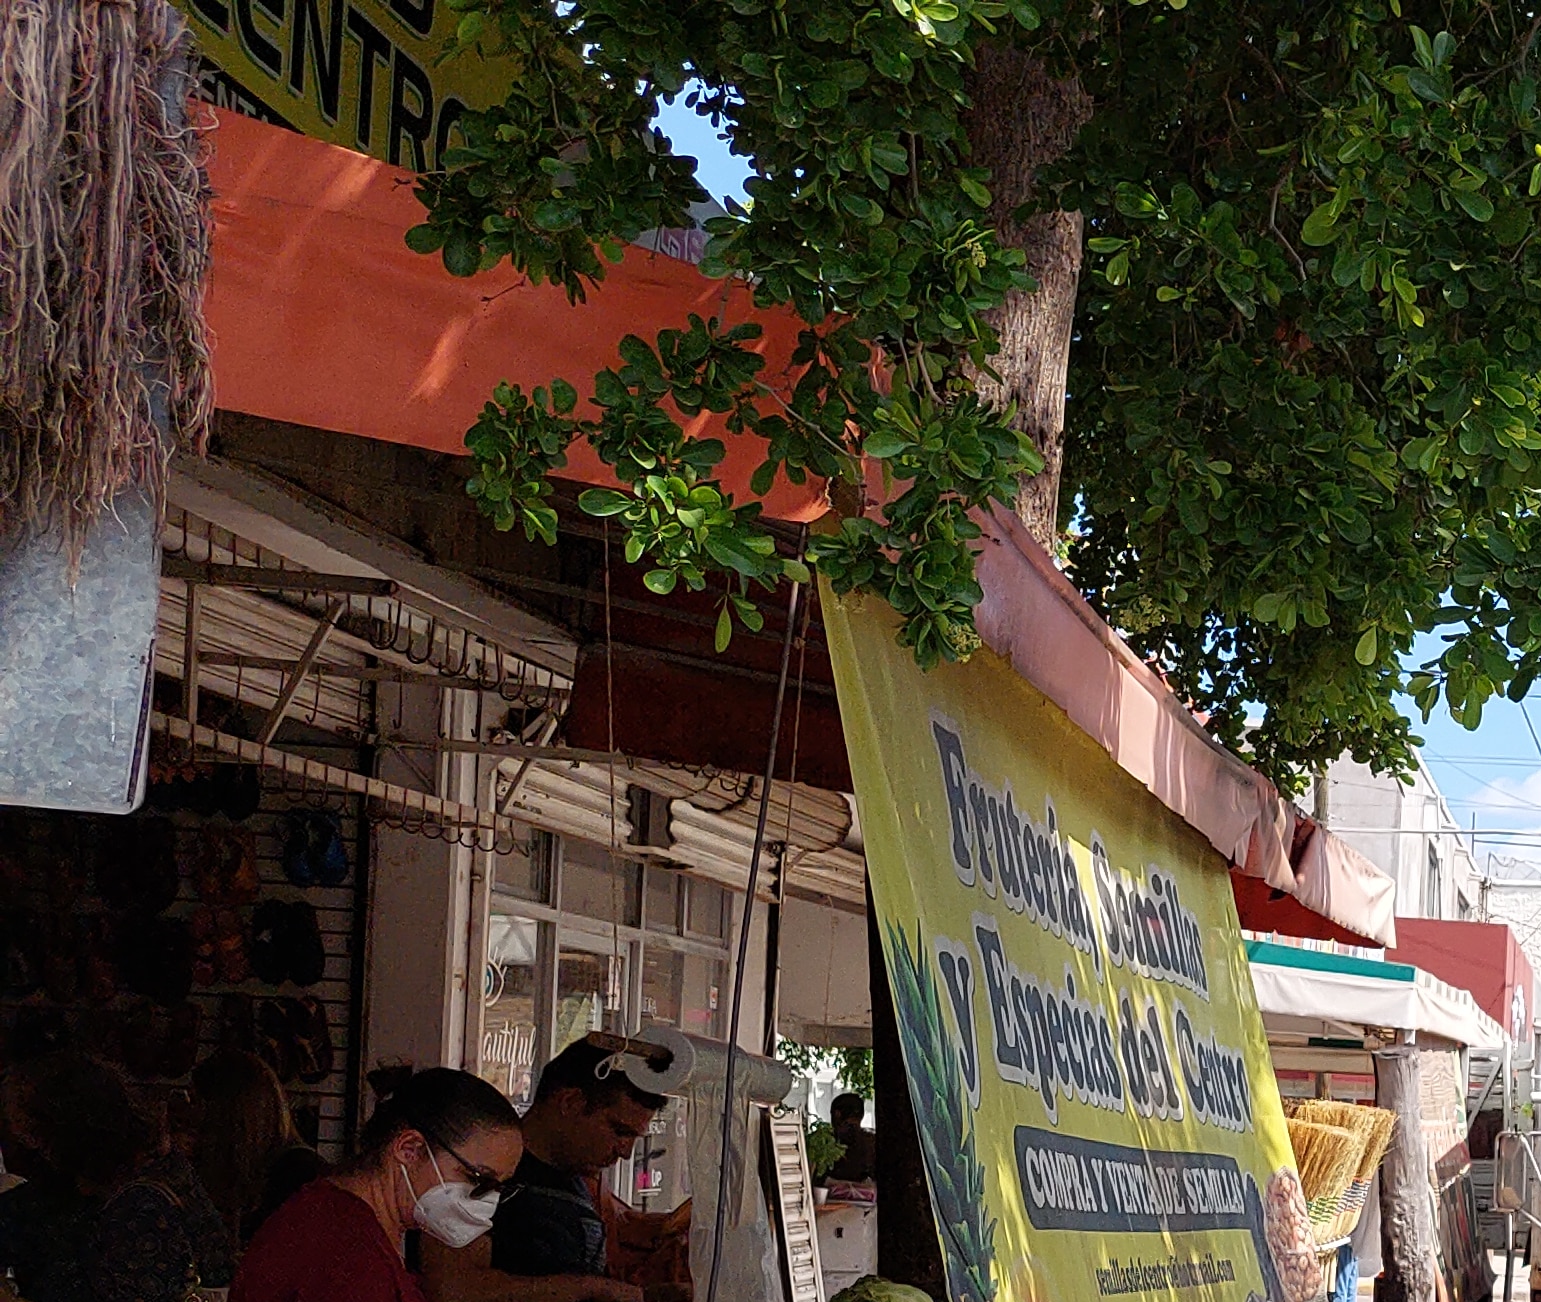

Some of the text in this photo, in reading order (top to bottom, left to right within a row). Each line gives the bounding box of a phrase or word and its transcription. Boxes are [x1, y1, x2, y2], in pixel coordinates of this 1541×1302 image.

[1091, 830, 1209, 998] Semillas
[972, 915, 1124, 1124] Especias
[1119, 986, 1184, 1121] del
[1174, 1000, 1254, 1133] Centro
[1025, 1146, 1246, 1216] COMPRA Y VENTA DE SEMILLAS
